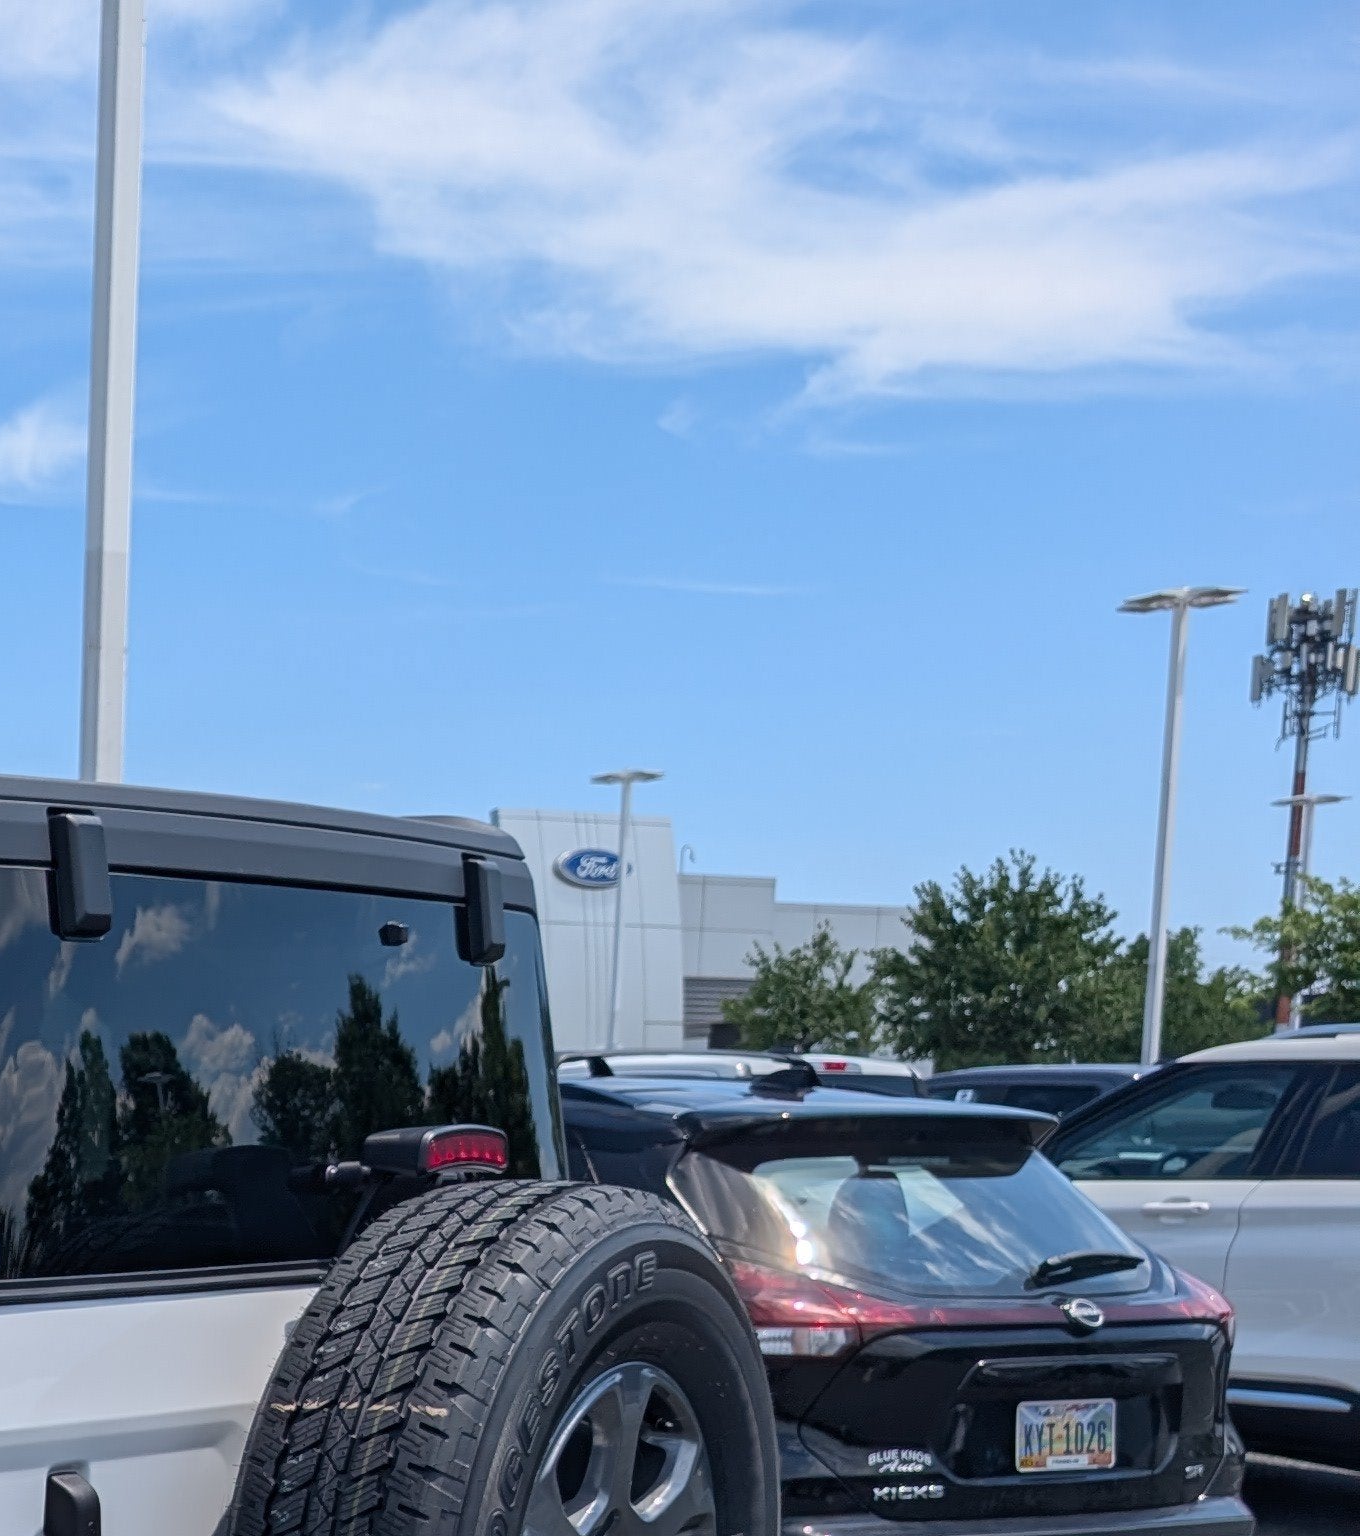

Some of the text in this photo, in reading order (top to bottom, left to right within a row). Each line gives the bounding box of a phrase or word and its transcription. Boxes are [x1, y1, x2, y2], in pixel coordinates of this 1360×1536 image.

[576, 854, 620, 879] Ford
[1063, 1420, 1108, 1455] 1026
[867, 1448, 899, 1467] BLUE
[872, 1484, 945, 1501] KICKS
